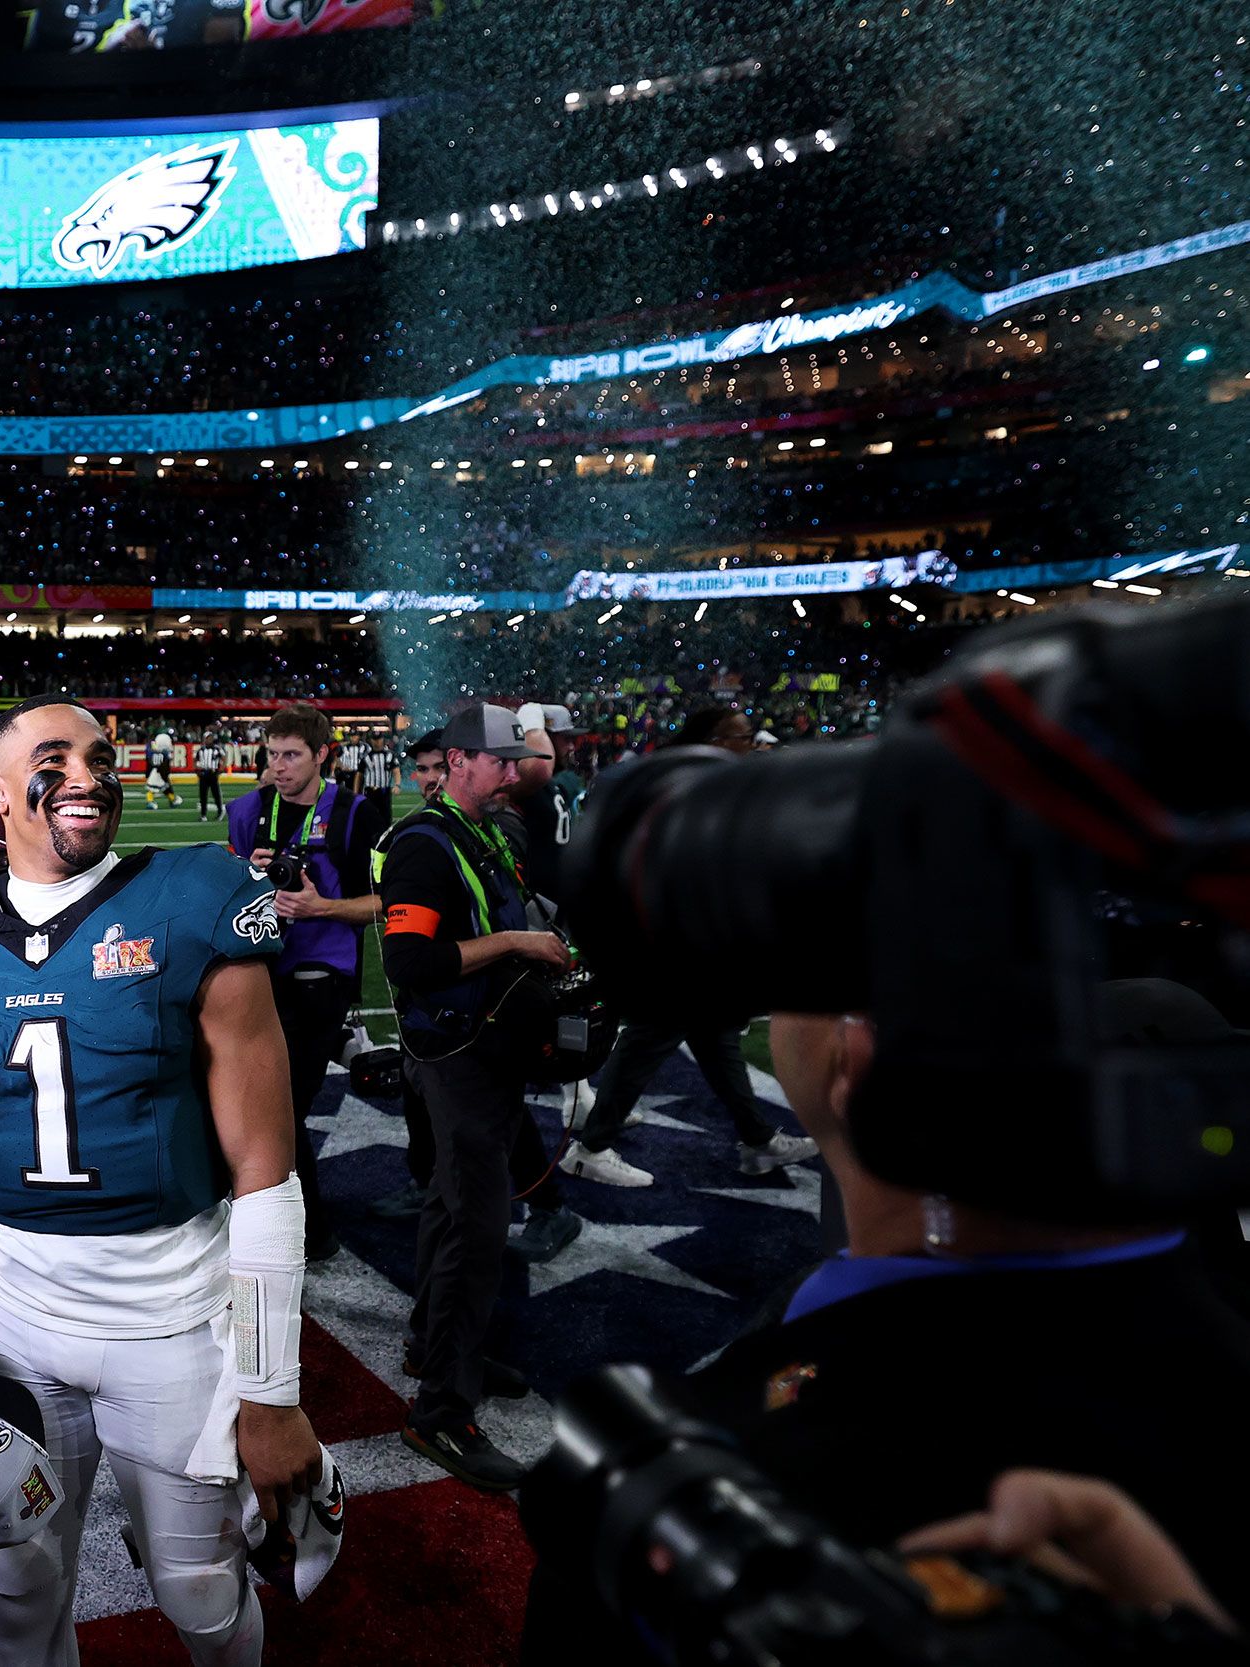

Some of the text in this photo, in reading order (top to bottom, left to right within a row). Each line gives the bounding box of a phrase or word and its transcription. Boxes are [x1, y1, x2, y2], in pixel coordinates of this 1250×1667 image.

[549, 300, 906, 382] SUPER BOWL Champions
[245, 590, 297, 609] SUPER
[300, 590, 365, 610] BOWL
[5, 992, 65, 1009] EAGLES
[5, 1016, 101, 1190] 1
